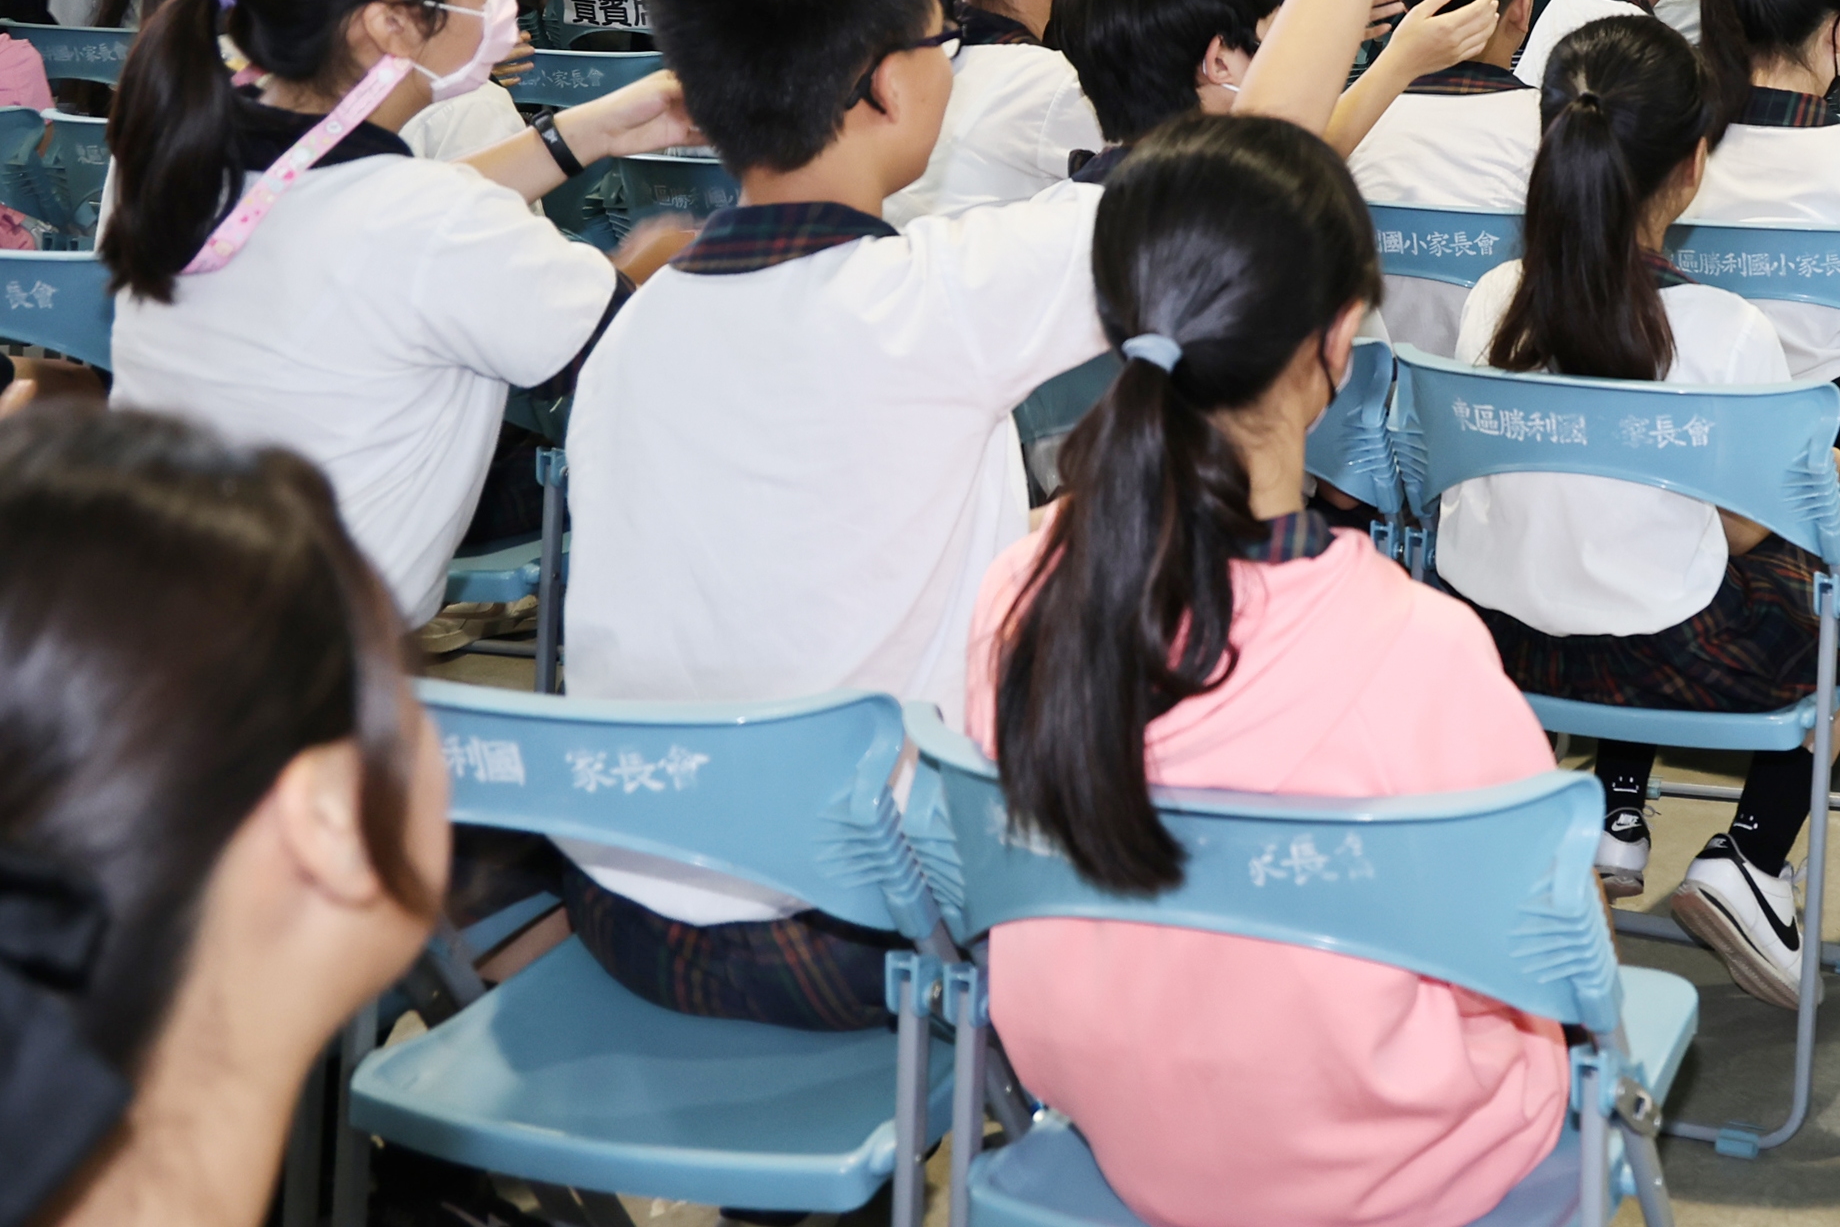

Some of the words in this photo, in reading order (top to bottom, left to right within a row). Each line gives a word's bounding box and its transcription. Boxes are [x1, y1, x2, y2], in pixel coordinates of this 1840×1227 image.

[1376, 230, 1500, 257] 國小家長會
